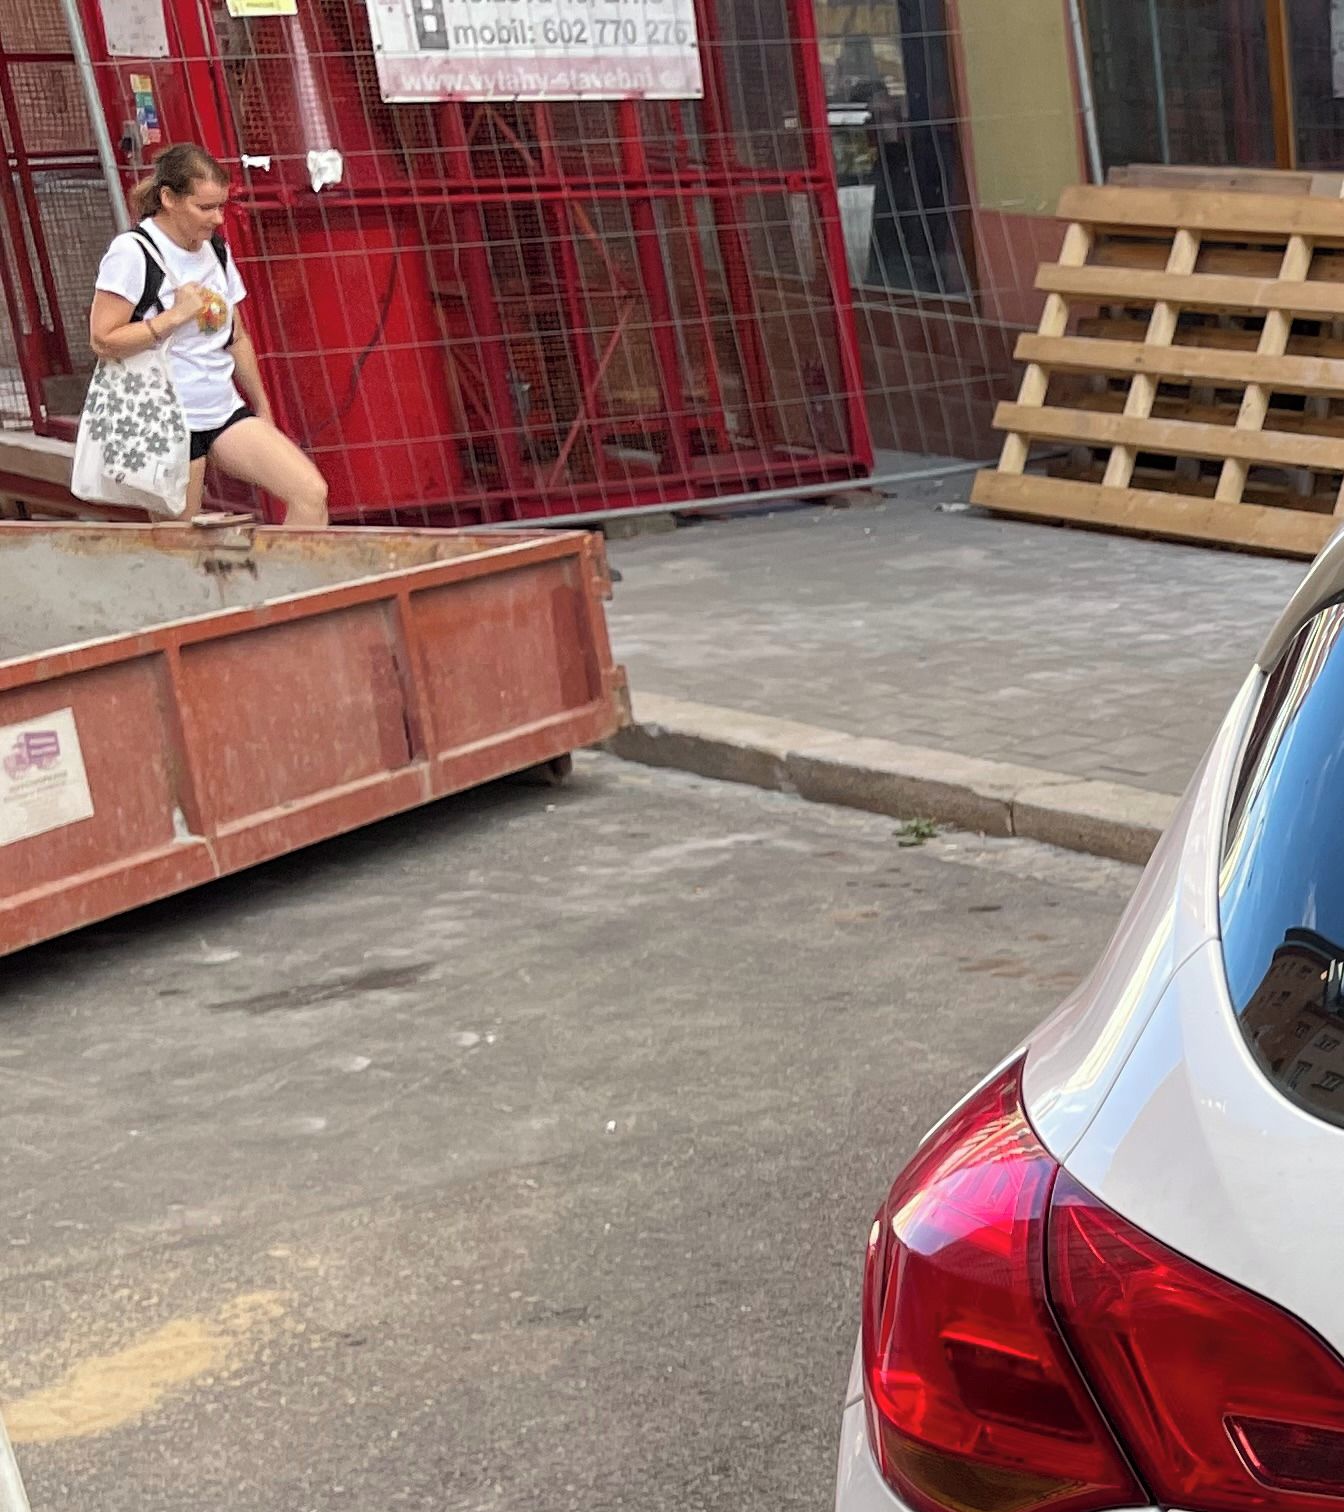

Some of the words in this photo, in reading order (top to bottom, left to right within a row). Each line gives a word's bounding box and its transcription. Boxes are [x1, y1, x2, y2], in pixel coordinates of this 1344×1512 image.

[453, 18, 536, 45] mobil:
[543, 18, 588, 44] 602
[594, 18, 637, 45] 770
